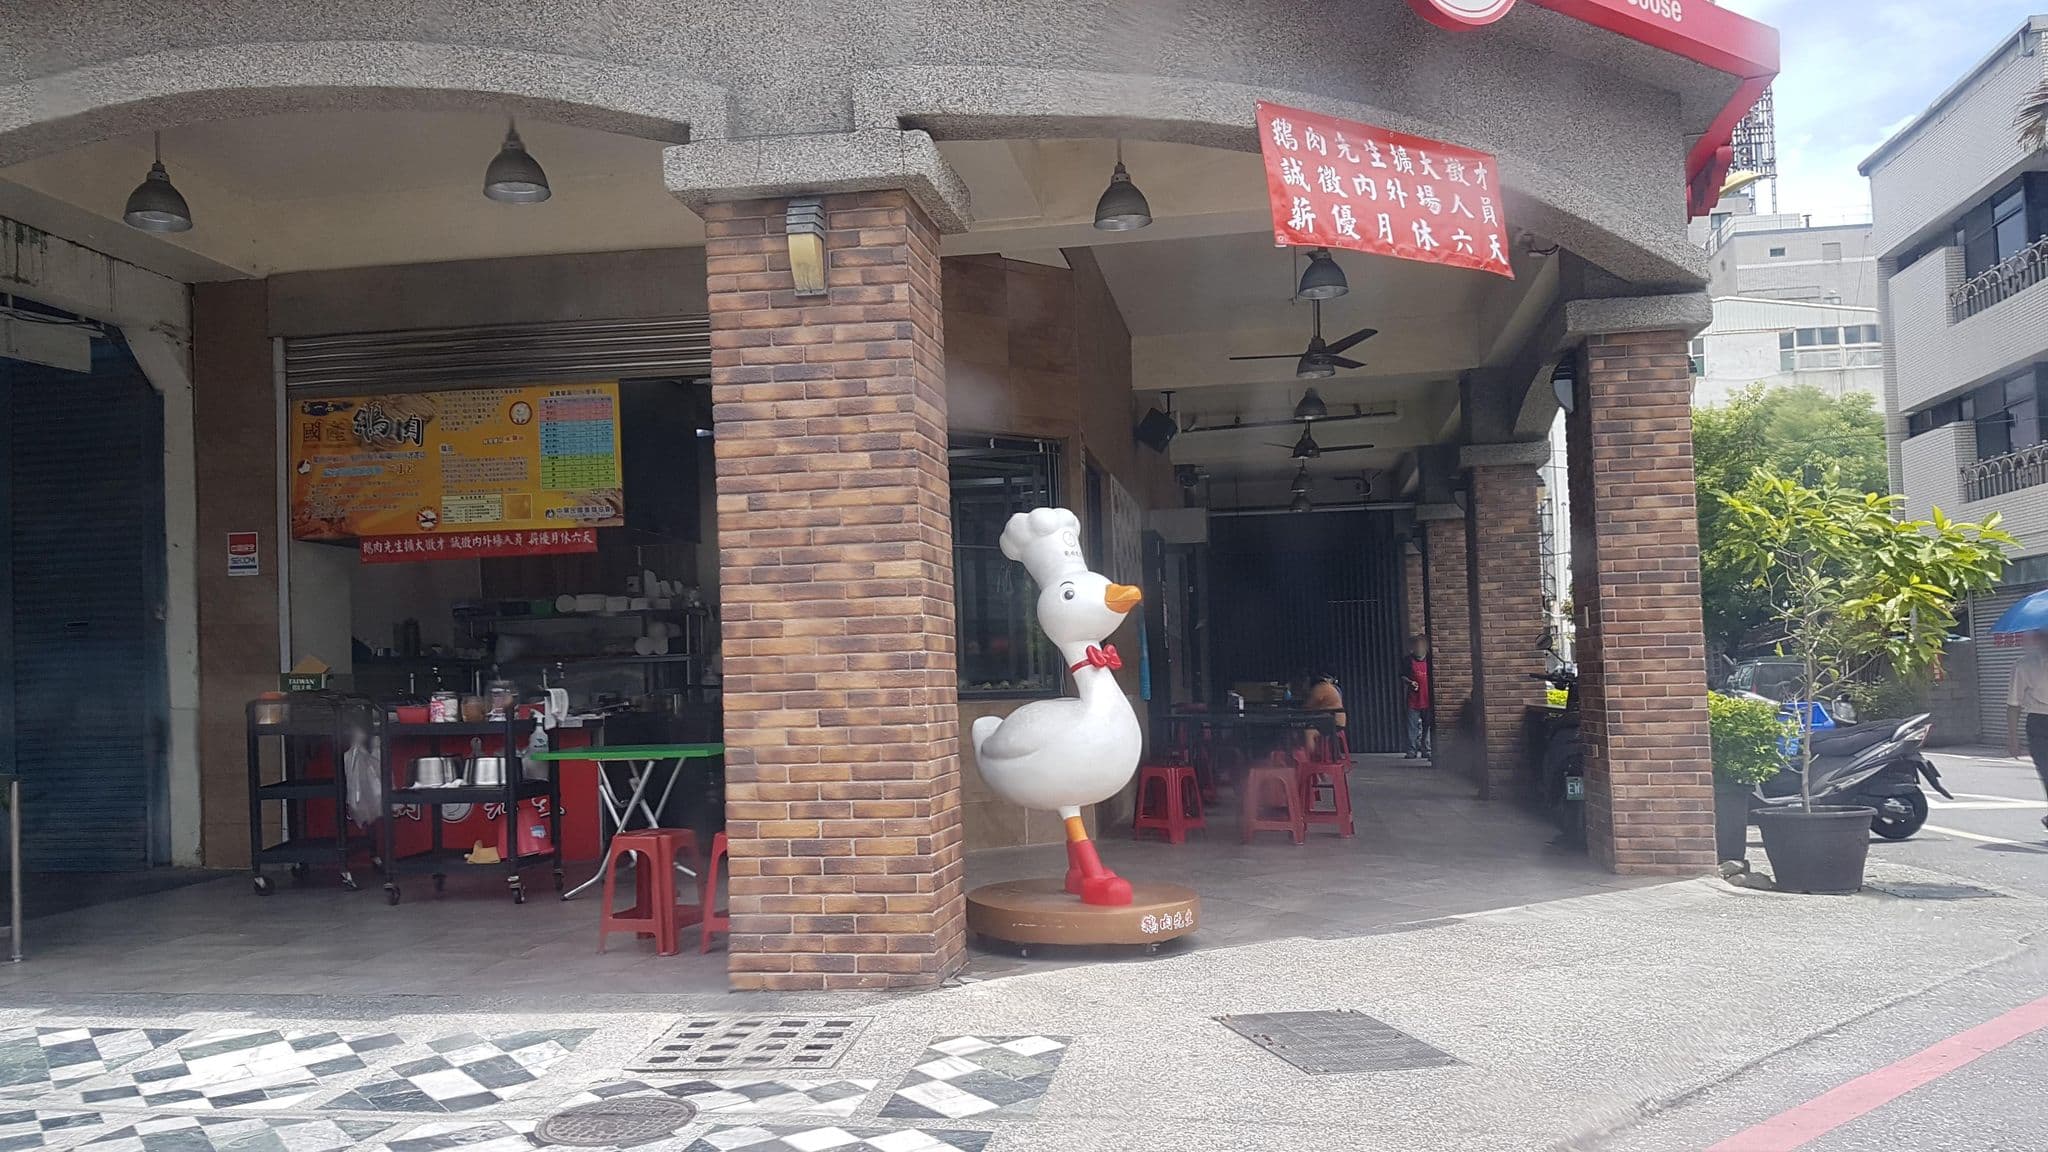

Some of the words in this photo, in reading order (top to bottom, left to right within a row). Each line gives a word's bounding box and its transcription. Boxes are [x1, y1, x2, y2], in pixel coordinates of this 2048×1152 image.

[1271, 117, 1488, 191] 鵝肉先生擴大徵才
[1280, 157, 1499, 228] 誠徵內外場人員
[1287, 195, 1508, 266] 薪優月休六天
[352, 400, 424, 447] 鵝肉
[528, 530, 593, 546] 薪優月休六天
